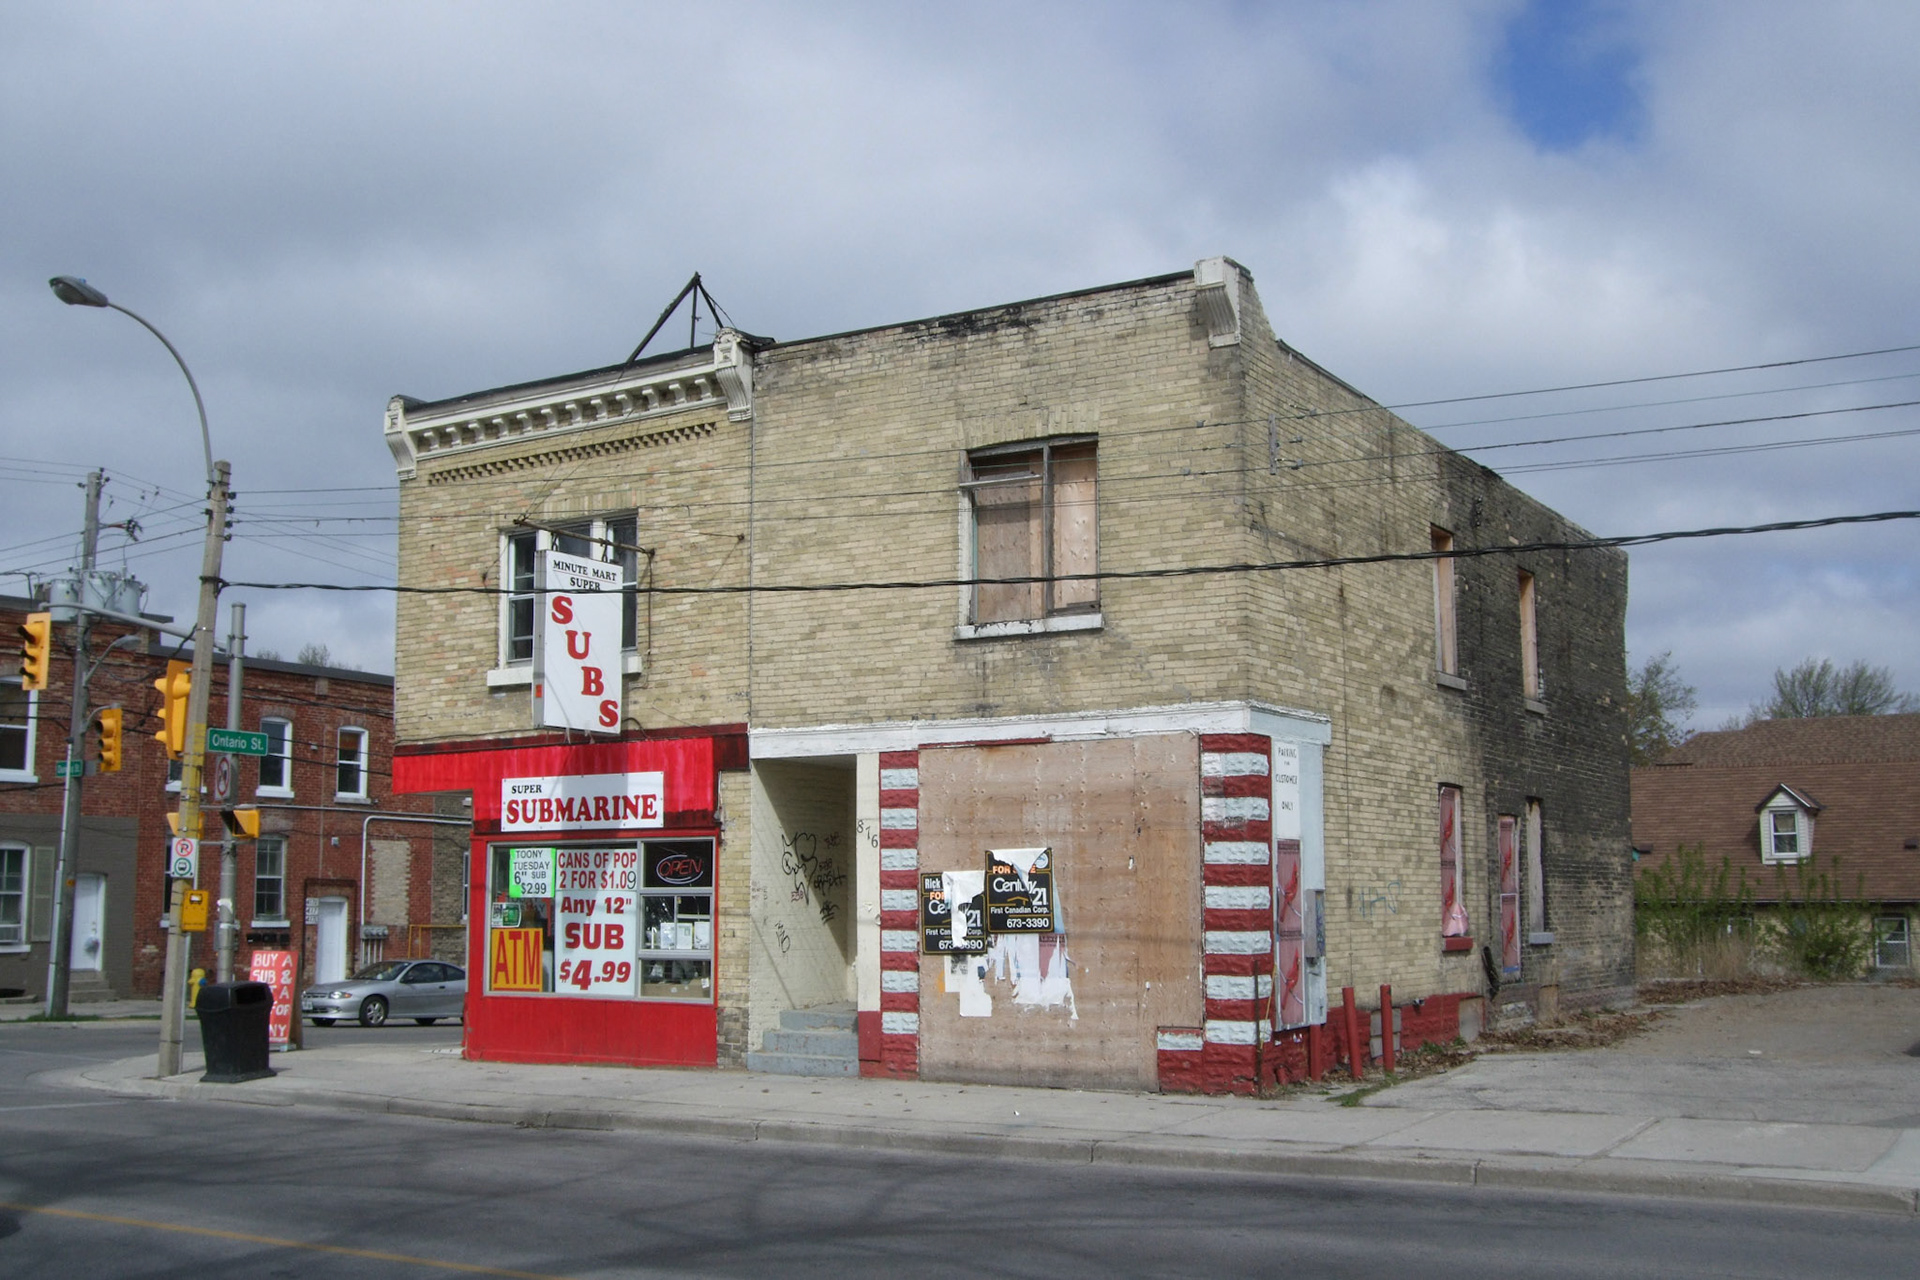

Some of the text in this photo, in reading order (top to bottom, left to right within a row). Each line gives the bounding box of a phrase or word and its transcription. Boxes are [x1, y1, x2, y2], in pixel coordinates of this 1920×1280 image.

[553, 559, 617, 581] MINUTE MART
[570, 577, 600, 591] SUPER
[212, 733, 264, 750] Ontario St.
[511, 784, 542, 794] SUPER
[506, 794, 657, 824] SUBMARINE
[516, 850, 543, 859] TOONY
[558, 852, 637, 868] CANS OF POP
[513, 861, 550, 871] TUESDAY
[660, 859, 702, 877] OPEN
[992, 865, 1011, 874] FOR
[531, 871, 546, 879] SUB
[560, 870, 637, 890] 2 FOR $1.09
[925, 878, 940, 889] Rick
[1032, 887, 1047, 906] 21
[560, 896, 597, 916] Any
[604, 896, 632, 914] 12"
[1004, 906, 1031, 914] Canadian
[1032, 906, 1049, 914] Corp.
[967, 909, 982, 928] 21
[1007, 918, 1049, 928] 673-3390
[565, 922, 624, 950] SUB
[925, 928, 938, 936] First
[253, 953, 293, 968] BUY A
[493, 930, 540, 985] ATM
[252, 969, 292, 985] SUB &
[559, 958, 632, 990] $4.99
[279, 985, 290, 999] A
